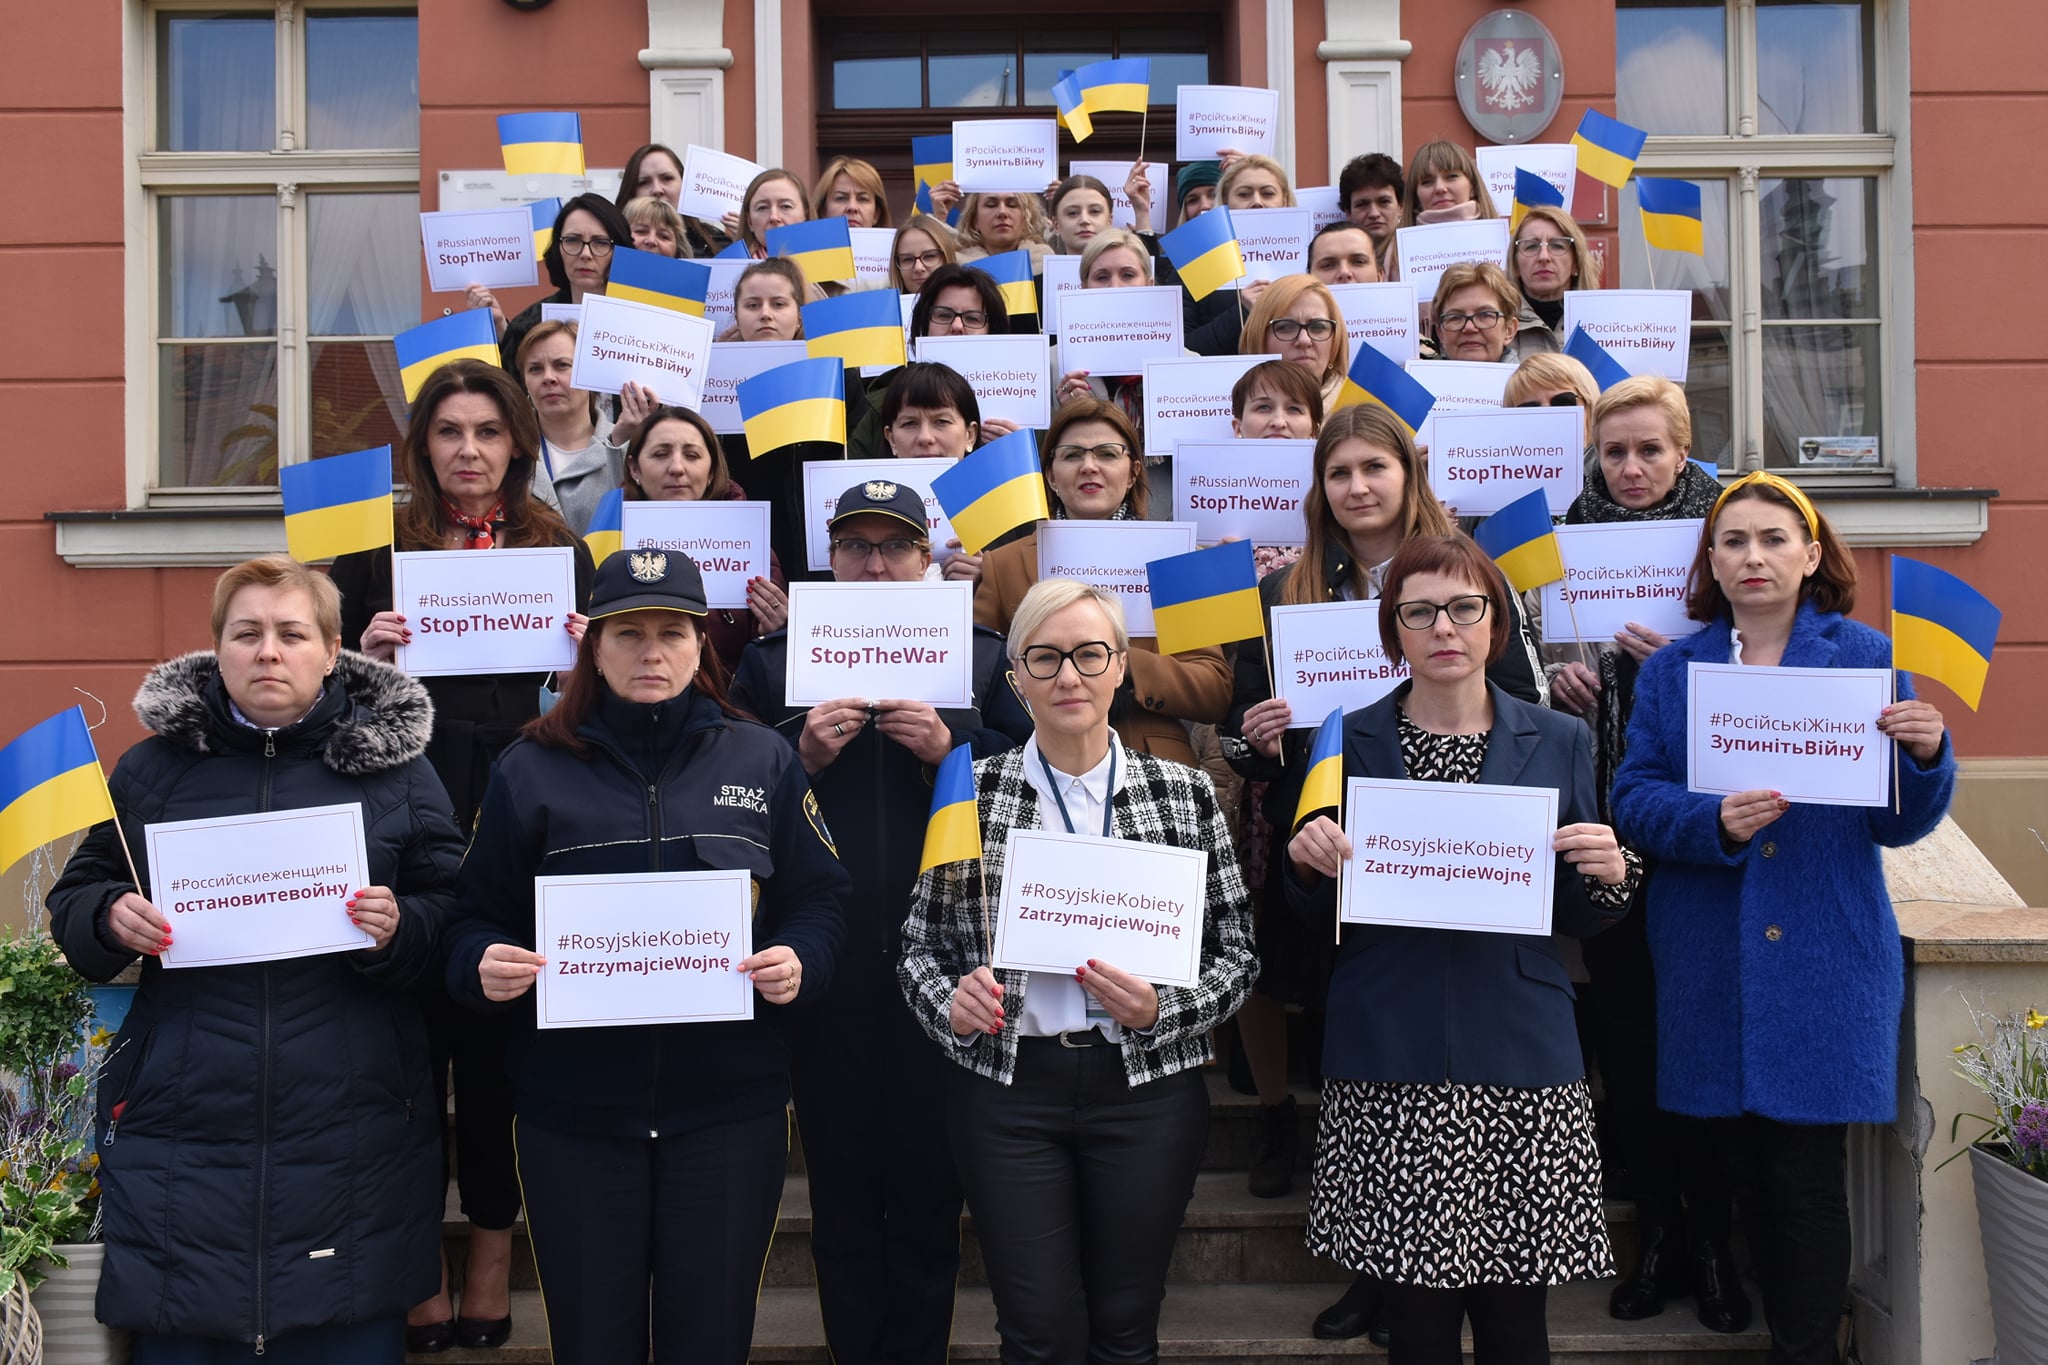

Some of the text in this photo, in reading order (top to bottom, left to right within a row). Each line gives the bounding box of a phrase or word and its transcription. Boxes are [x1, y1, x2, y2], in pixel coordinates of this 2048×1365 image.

[1189, 112, 1266, 125] #РосійськіЖінки
[1189, 125, 1265, 139] ЗупинітьВійну
[965, 144, 1045, 156] #РосійськіЖінки
[966, 157, 1044, 168] ЗупинітьВійну
[437, 236, 520, 250] #RussianWomen
[1237, 236, 1299, 249] ssianWomen
[440, 250, 521, 266] StopTheWar
[1241, 250, 1300, 262] pTheWar
[1069, 321, 1171, 333] #Российскиеженщины
[1346, 317, 1407, 327] киеженщины
[1070, 331, 1171, 343] остановитевойну
[1348, 327, 1407, 338] итевойну
[593, 330, 694, 360] #РосійськіЖінки
[1597, 337, 1675, 351] пинітьВійну
[592, 346, 692, 378] ЗупинітьВійну
[964, 371, 1037, 383] jskieKobiety
[977, 386, 1036, 399] ajcieWojnę
[1157, 393, 1232, 404] #Российскиеже
[1158, 406, 1234, 419] остановите
[1448, 445, 1563, 458] #RussianWomen
[1190, 476, 1299, 488] #RussianWomen
[1448, 465, 1563, 484] StopTheWar
[1191, 495, 1299, 514] StopTheWar
[637, 537, 751, 549] #RussianWomen
[1050, 565, 1146, 577] #Российскиежен
[419, 592, 553, 607] #RussianWomen
[1560, 583, 1686, 604] ЗупинітьВійну
[421, 613, 553, 637] StopTheWar
[811, 625, 948, 638] #RussianWomen
[811, 647, 948, 668] StopTheWar
[1294, 644, 1386, 663] #Російські
[1710, 713, 1864, 734] #РосійськіЖінки
[1711, 735, 1864, 761] ЗупинітьВійну
[721, 785, 765, 801] STRAŻ
[713, 795, 768, 815] MIEJSKA
[1365, 835, 1534, 863] #RosyjskieKobiety
[171, 862, 348, 892] #Российскиеженщины
[1365, 860, 1531, 886] ZatrzymajcieWojnę
[174, 881, 349, 914] остановитевойну
[1021, 883, 1184, 917] #RosyjskieKobiety
[1019, 907, 1180, 939] ZatrzymajcieWojnę
[558, 929, 730, 953] #RosyjskieKobiety
[559, 955, 729, 977] ZatrzymajcieWojnę
